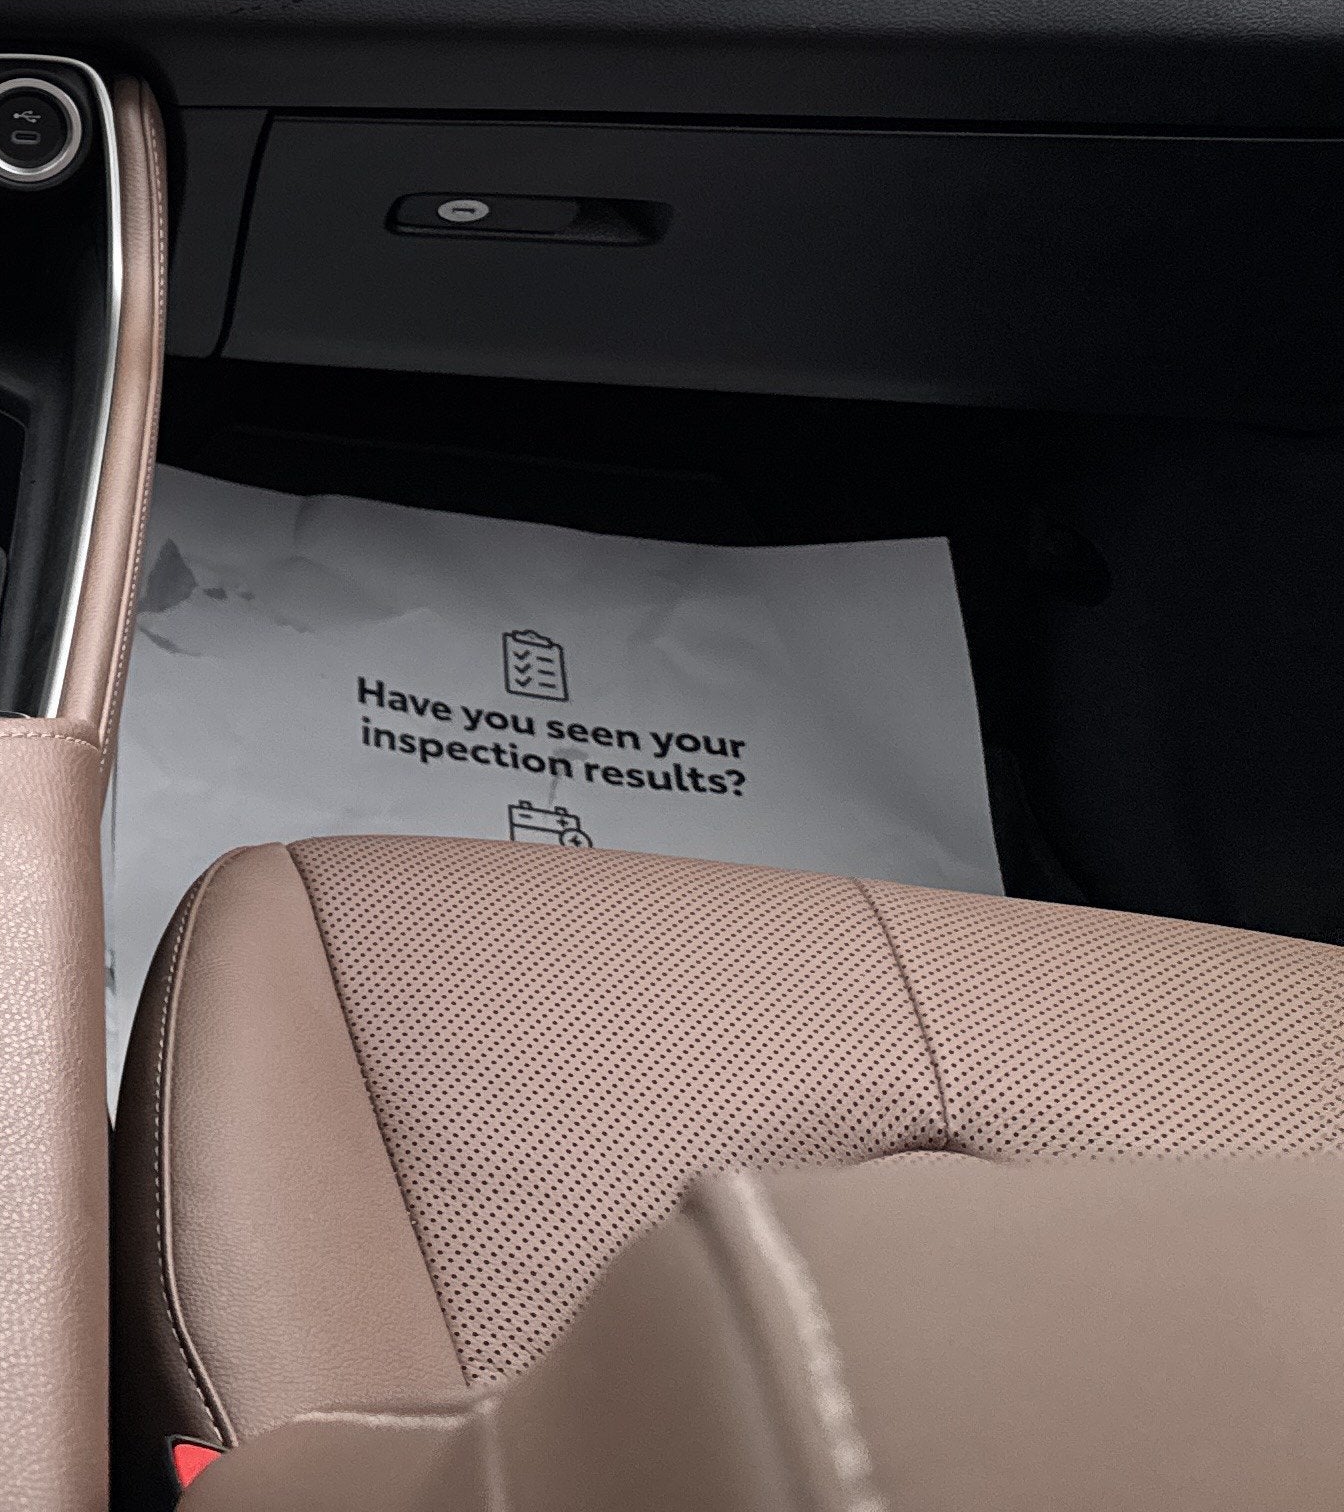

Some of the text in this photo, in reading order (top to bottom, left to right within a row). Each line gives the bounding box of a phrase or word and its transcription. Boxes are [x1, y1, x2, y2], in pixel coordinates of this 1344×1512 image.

[356, 676, 746, 763] Have you seen your
[359, 715, 747, 798] inspection results?
